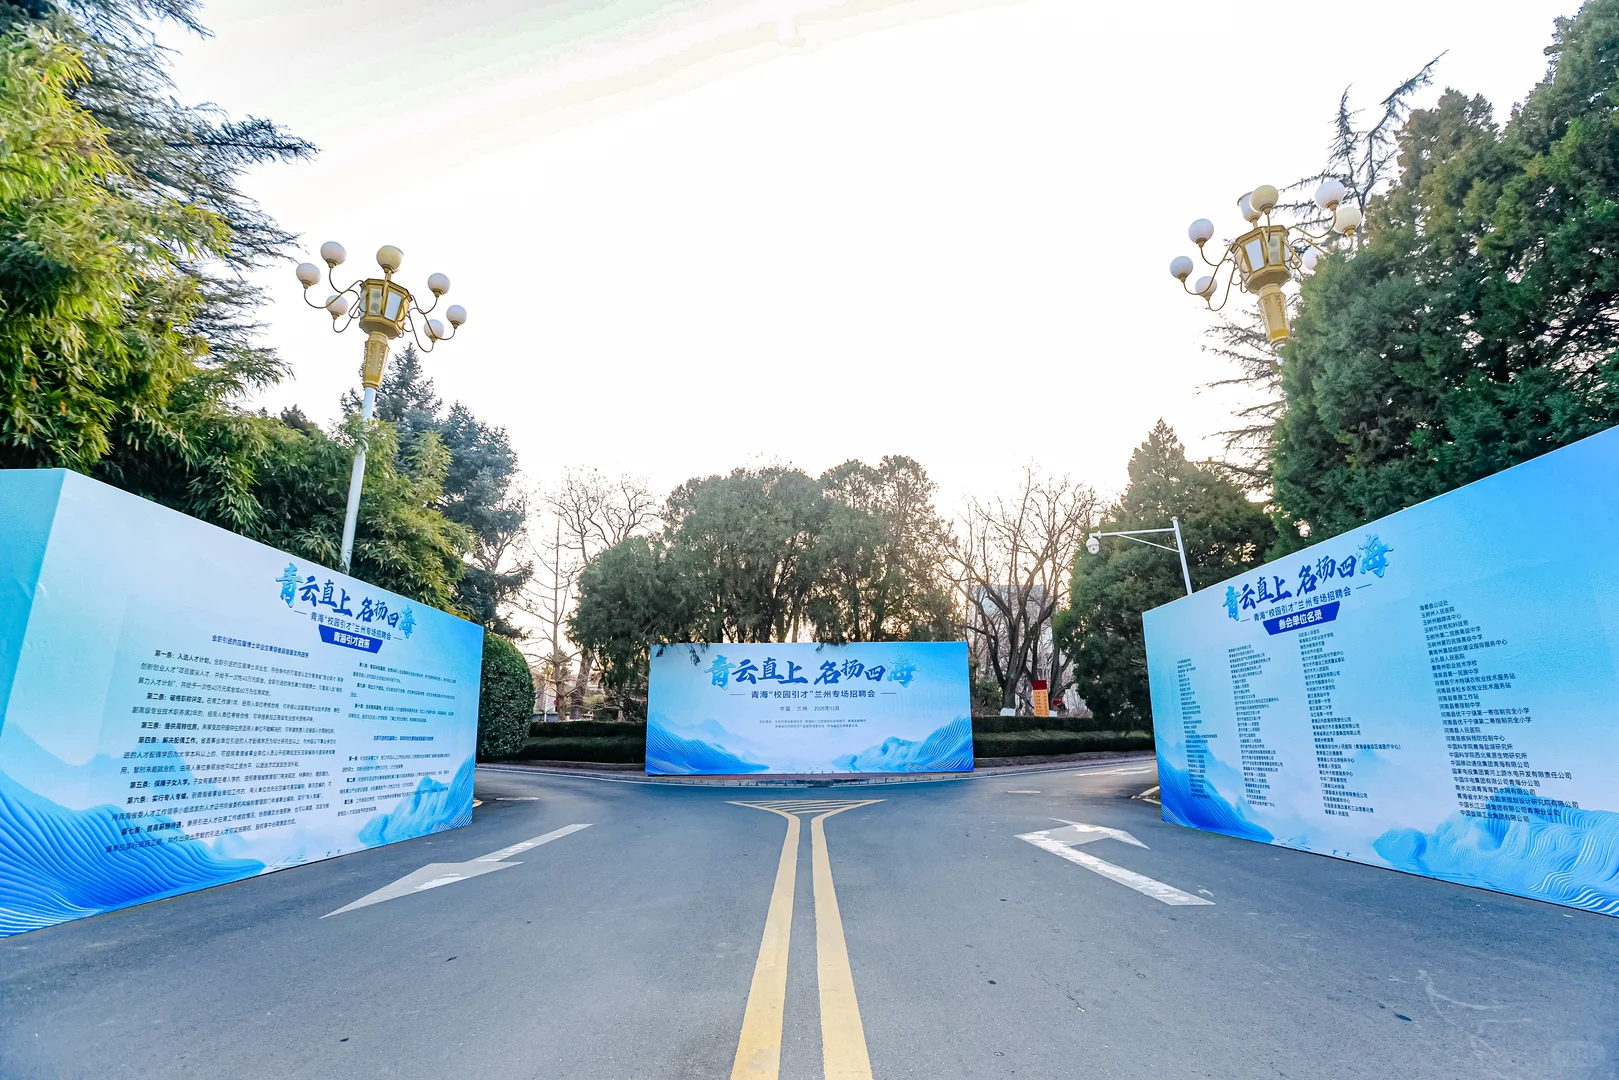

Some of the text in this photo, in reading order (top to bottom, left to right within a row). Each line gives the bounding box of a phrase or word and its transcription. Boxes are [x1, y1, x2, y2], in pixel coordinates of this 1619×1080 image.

[1222, 534, 1394, 622] 青云直上 名扬四海
[275, 562, 416, 640] 青云直上 名扬四海
[1421, 606, 1455, 618] 玉树州人民医院
[1279, 610, 1322, 631] 参会单位名录
[1423, 613, 1461, 625] 玉树州融媒体中心
[1424, 620, 1468, 633] 玉树市农牧和科技局
[1426, 626, 1480, 640] 玉树州第二民族高级中学
[334, 632, 370, 650] 青海引才政策
[1427, 634, 1482, 648] 玉树州第四民族高级中学
[1428, 639, 1507, 655] 黄南州基层组织建设指导服务中心
[1430, 653, 1465, 663] 尖扎县人民医院
[1431, 660, 1477, 670] 黄南州职业技术学校
[704, 655, 921, 690] 青云直上 名扬四海
[1435, 673, 1515, 686] 河南县宁木特镇农牧业技术服务站
[1436, 682, 1511, 694] 河南县多松乡农牧业技术服务站
[1437, 693, 1479, 701] 河南县草原工作站
[1439, 701, 1480, 709] 河南县寄宿制中学
[1441, 707, 1528, 717] 河南县优干宁镇第一寄宿制完全小学
[1442, 716, 1530, 725] 河南县优干宁镇第二寄宿制完全小学
[1449, 751, 1527, 759] 中国科学院西北高原生物研究所
[1451, 759, 1529, 768] 中国移动通信集团青海有限公司
[1452, 768, 1571, 778] 国家电投集团黄河上游水电开发有限责任公司
[1454, 776, 1540, 786] 中国华电集团有限公司青海分公司
[1455, 784, 1535, 796] 南水北调青海海西水网有限公司
[1457, 793, 1578, 809] 青海省水利水电勘测规划设计研究院有限公司
[1459, 801, 1561, 817] 中国长江三峡集团有限公司青海分公司
[1460, 809, 1529, 822] 中国盐湖工业集团有限公司
